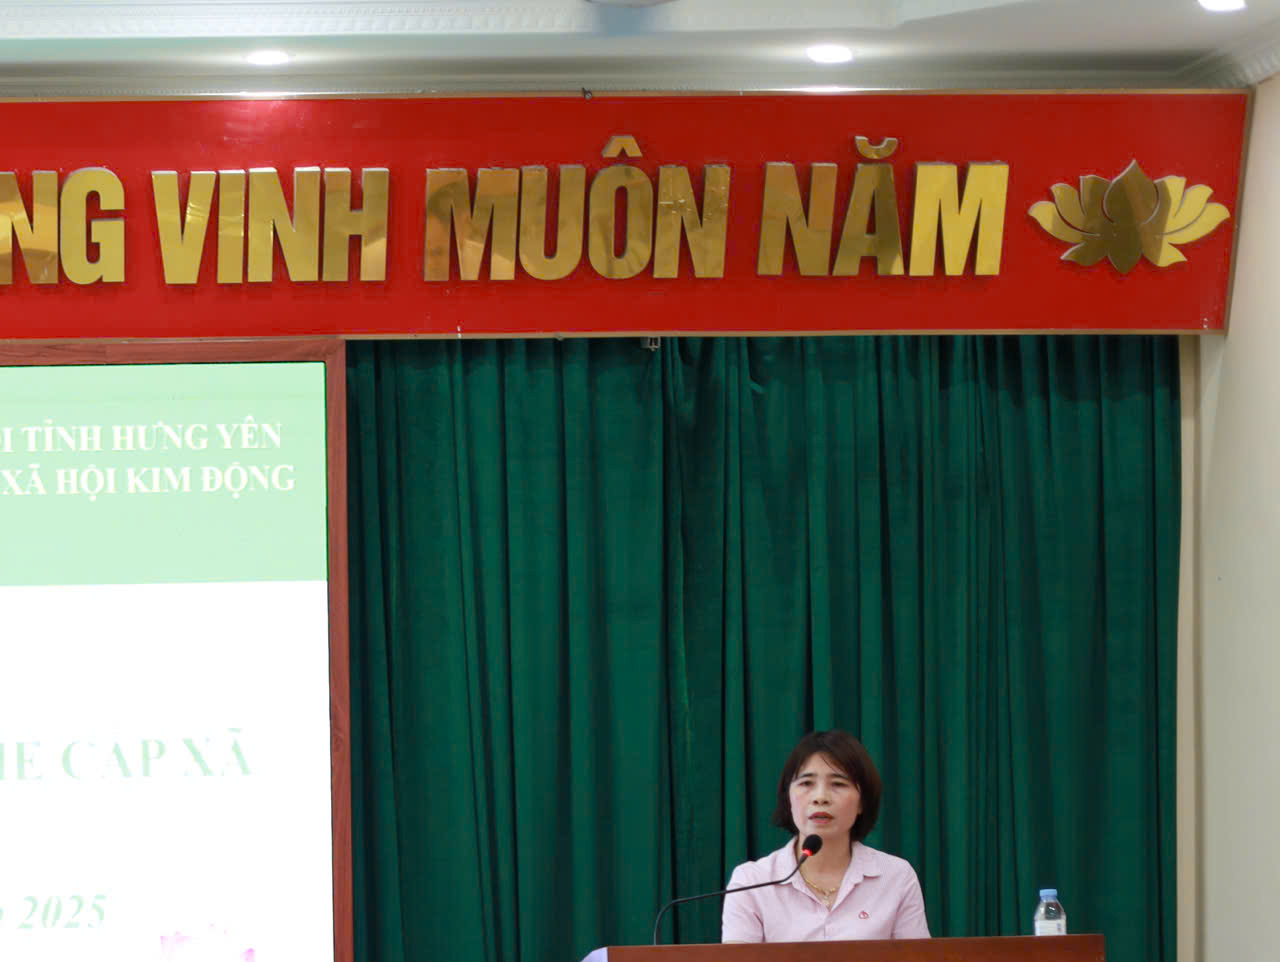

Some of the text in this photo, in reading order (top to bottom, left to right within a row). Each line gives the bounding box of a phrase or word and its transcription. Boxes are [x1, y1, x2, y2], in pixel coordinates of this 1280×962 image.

[151, 165, 389, 285] VINH
[423, 134, 731, 282] MUÔN
[757, 135, 1009, 277] NĂM
[111, 420, 209, 451] HƯNG
[216, 414, 283, 449] YÊN
[0, 462, 48, 497] XÃ
[55, 463, 117, 502] HỘI
[126, 464, 193, 494] KIM
[200, 461, 296, 500] ĐỘNG
[16, 893, 108, 930] 2025
